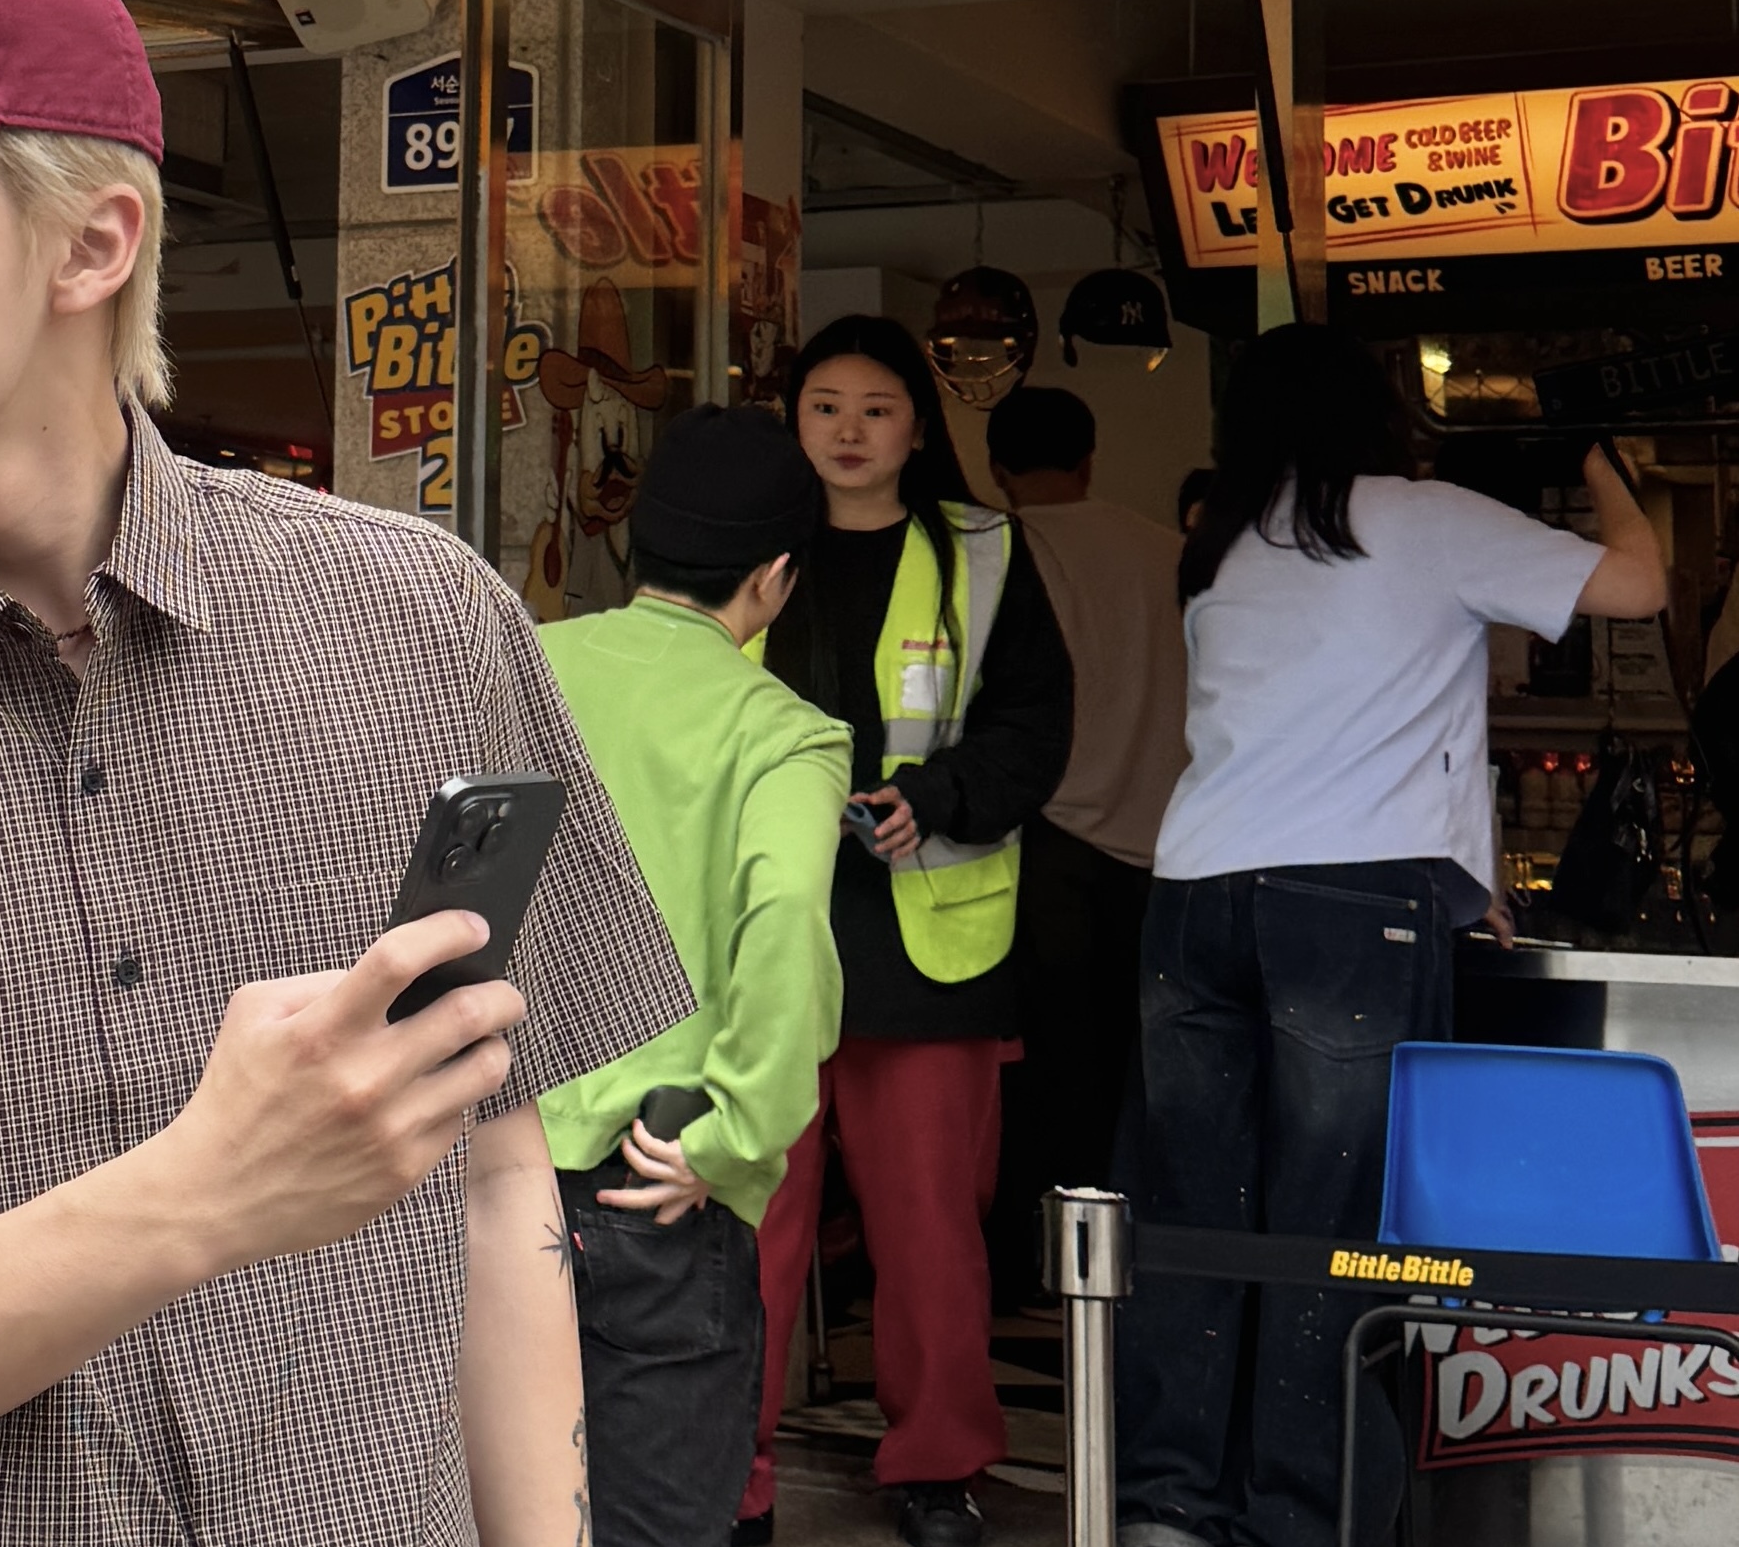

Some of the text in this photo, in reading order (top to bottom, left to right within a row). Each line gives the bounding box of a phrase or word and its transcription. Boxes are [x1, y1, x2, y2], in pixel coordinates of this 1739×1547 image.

[1405, 118, 1512, 149] COLD BEER
[1327, 195, 1390, 223] GET
[1395, 178, 1517, 215] DRUNK
[1348, 269, 1444, 295] SNACK
[1647, 254, 1723, 281] BEER
